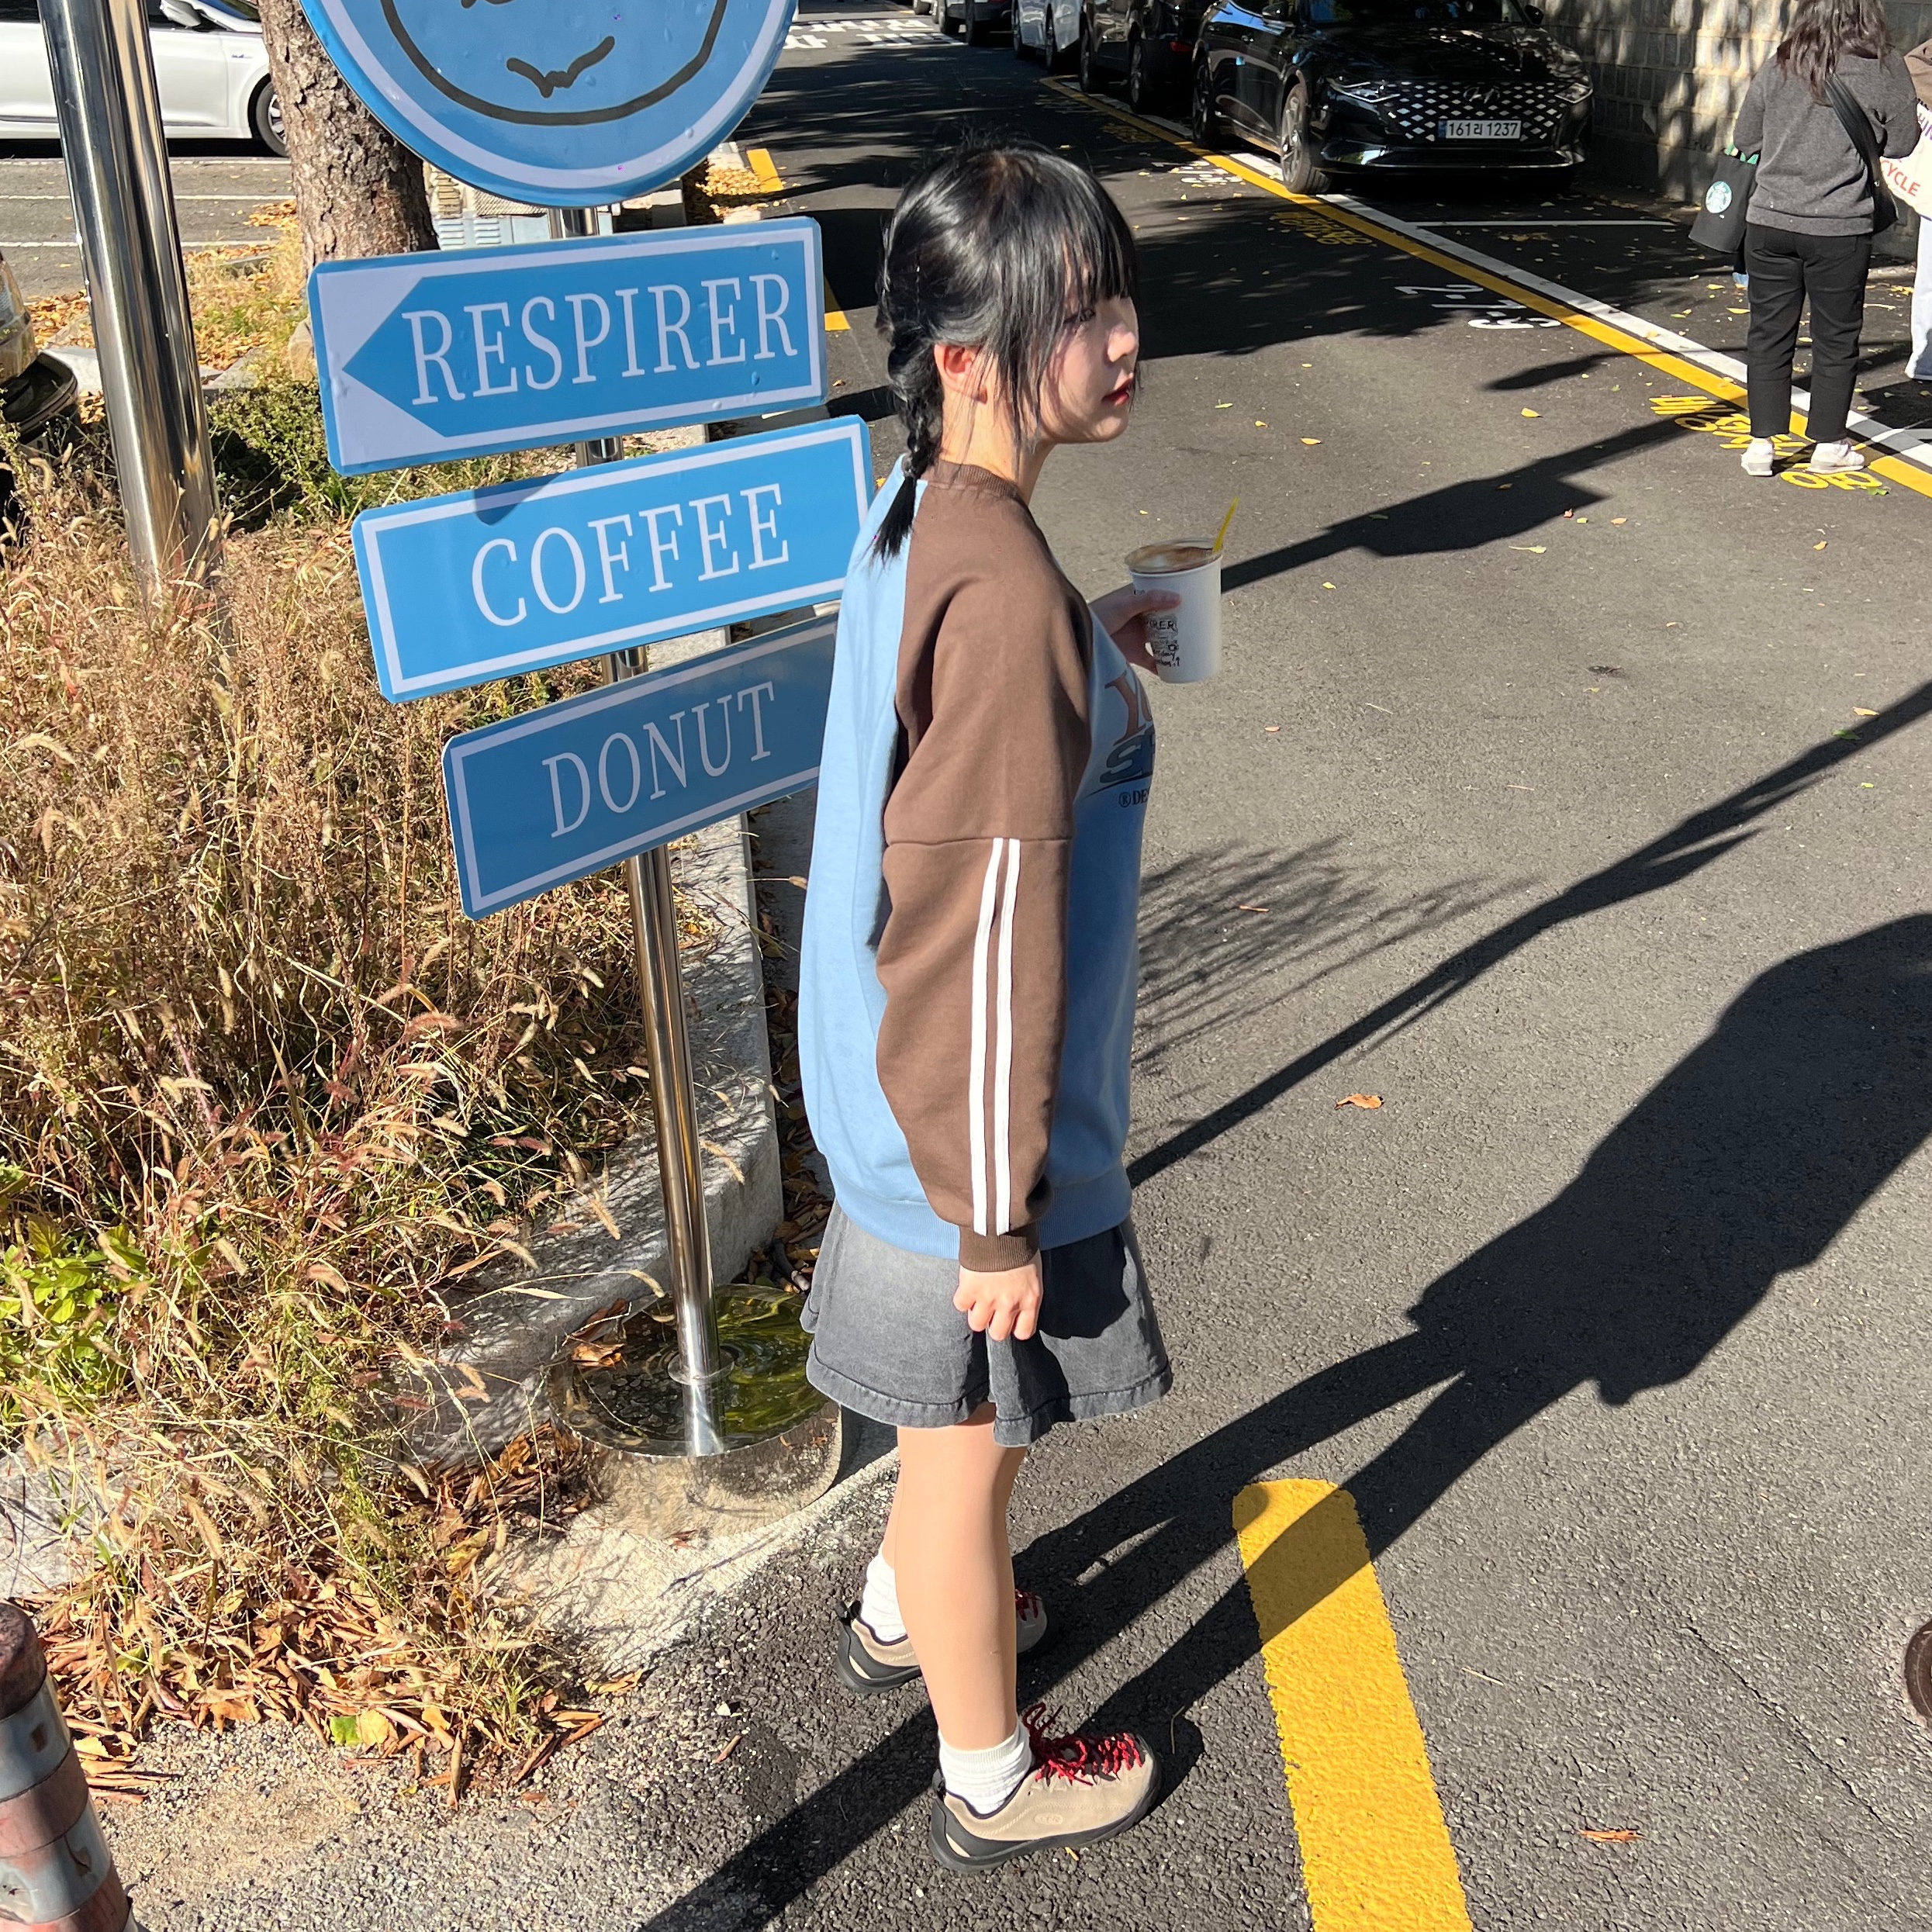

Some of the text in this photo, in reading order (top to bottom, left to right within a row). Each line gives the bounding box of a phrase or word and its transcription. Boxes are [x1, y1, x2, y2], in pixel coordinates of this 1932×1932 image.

[1487, 122, 1519, 136] 1237
[401, 273, 797, 406] RESPIRER
[472, 482, 790, 627] COFFEE
[541, 681, 775, 838] DONUT
